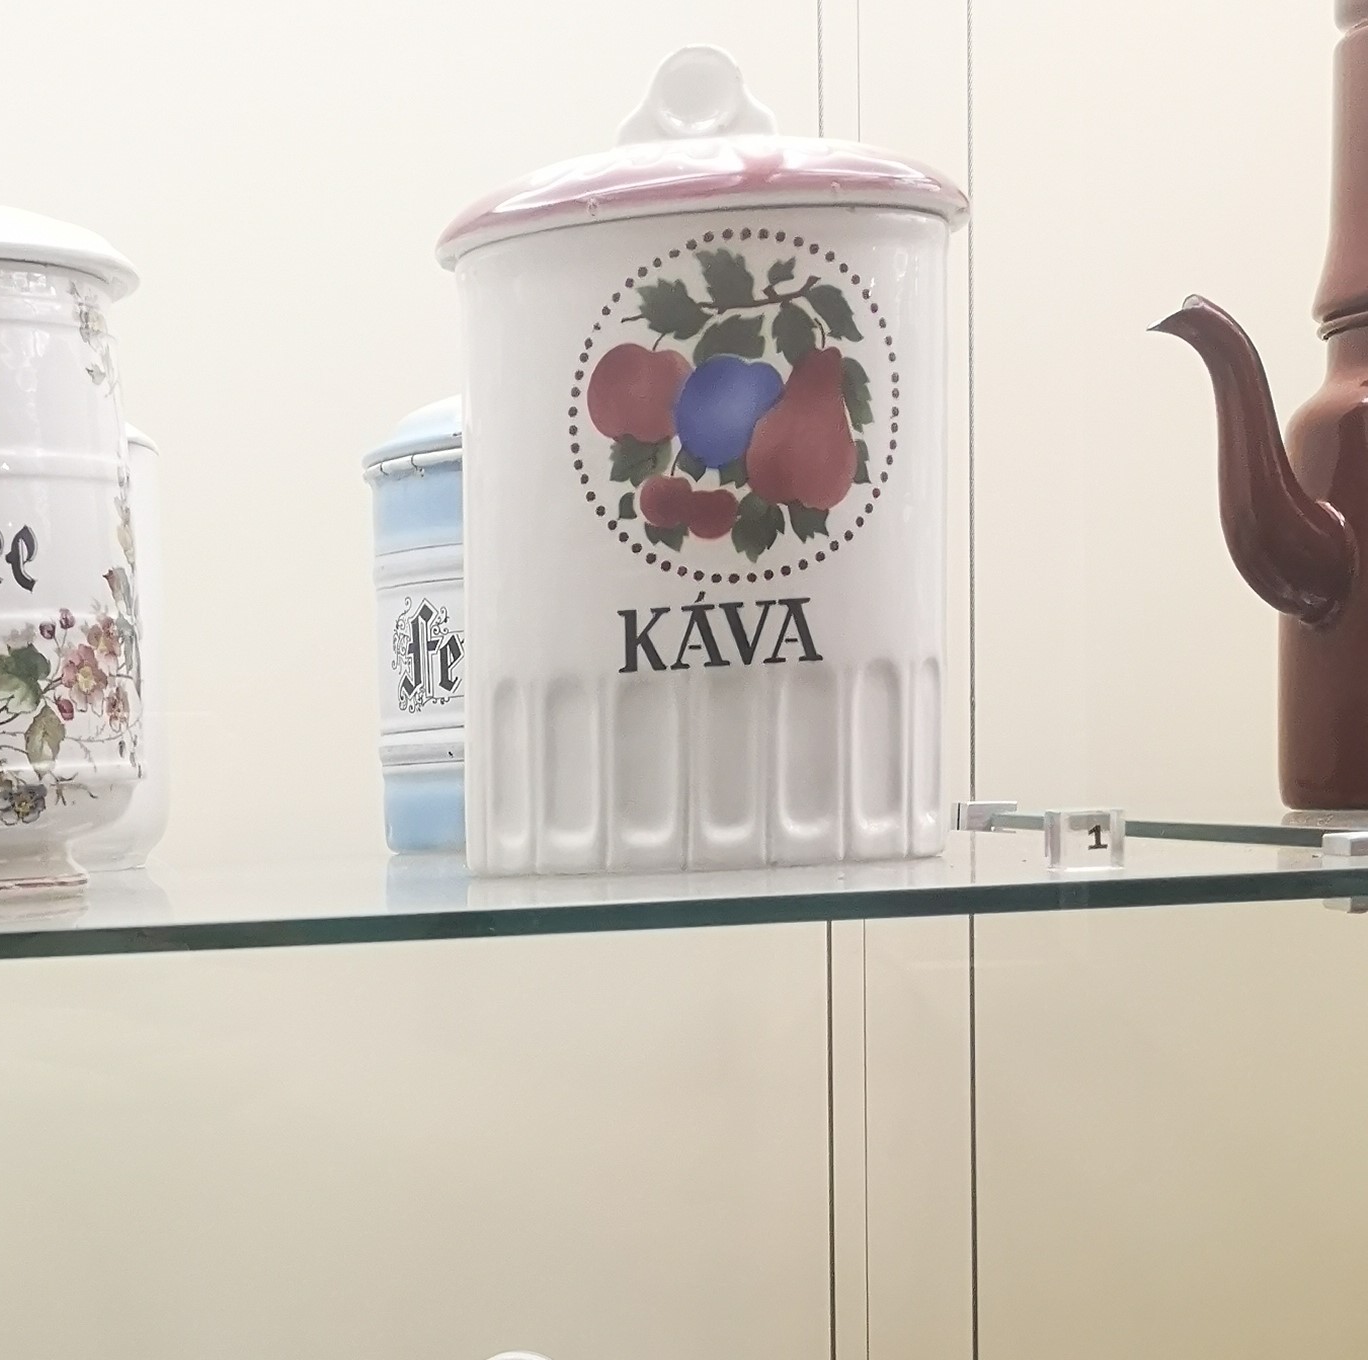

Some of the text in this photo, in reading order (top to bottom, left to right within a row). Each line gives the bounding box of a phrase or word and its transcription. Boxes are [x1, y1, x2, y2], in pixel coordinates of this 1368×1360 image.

[399, 597, 465, 701] fe
[617, 590, 824, 674] KÁVA
[1087, 824, 1108, 851] 1
